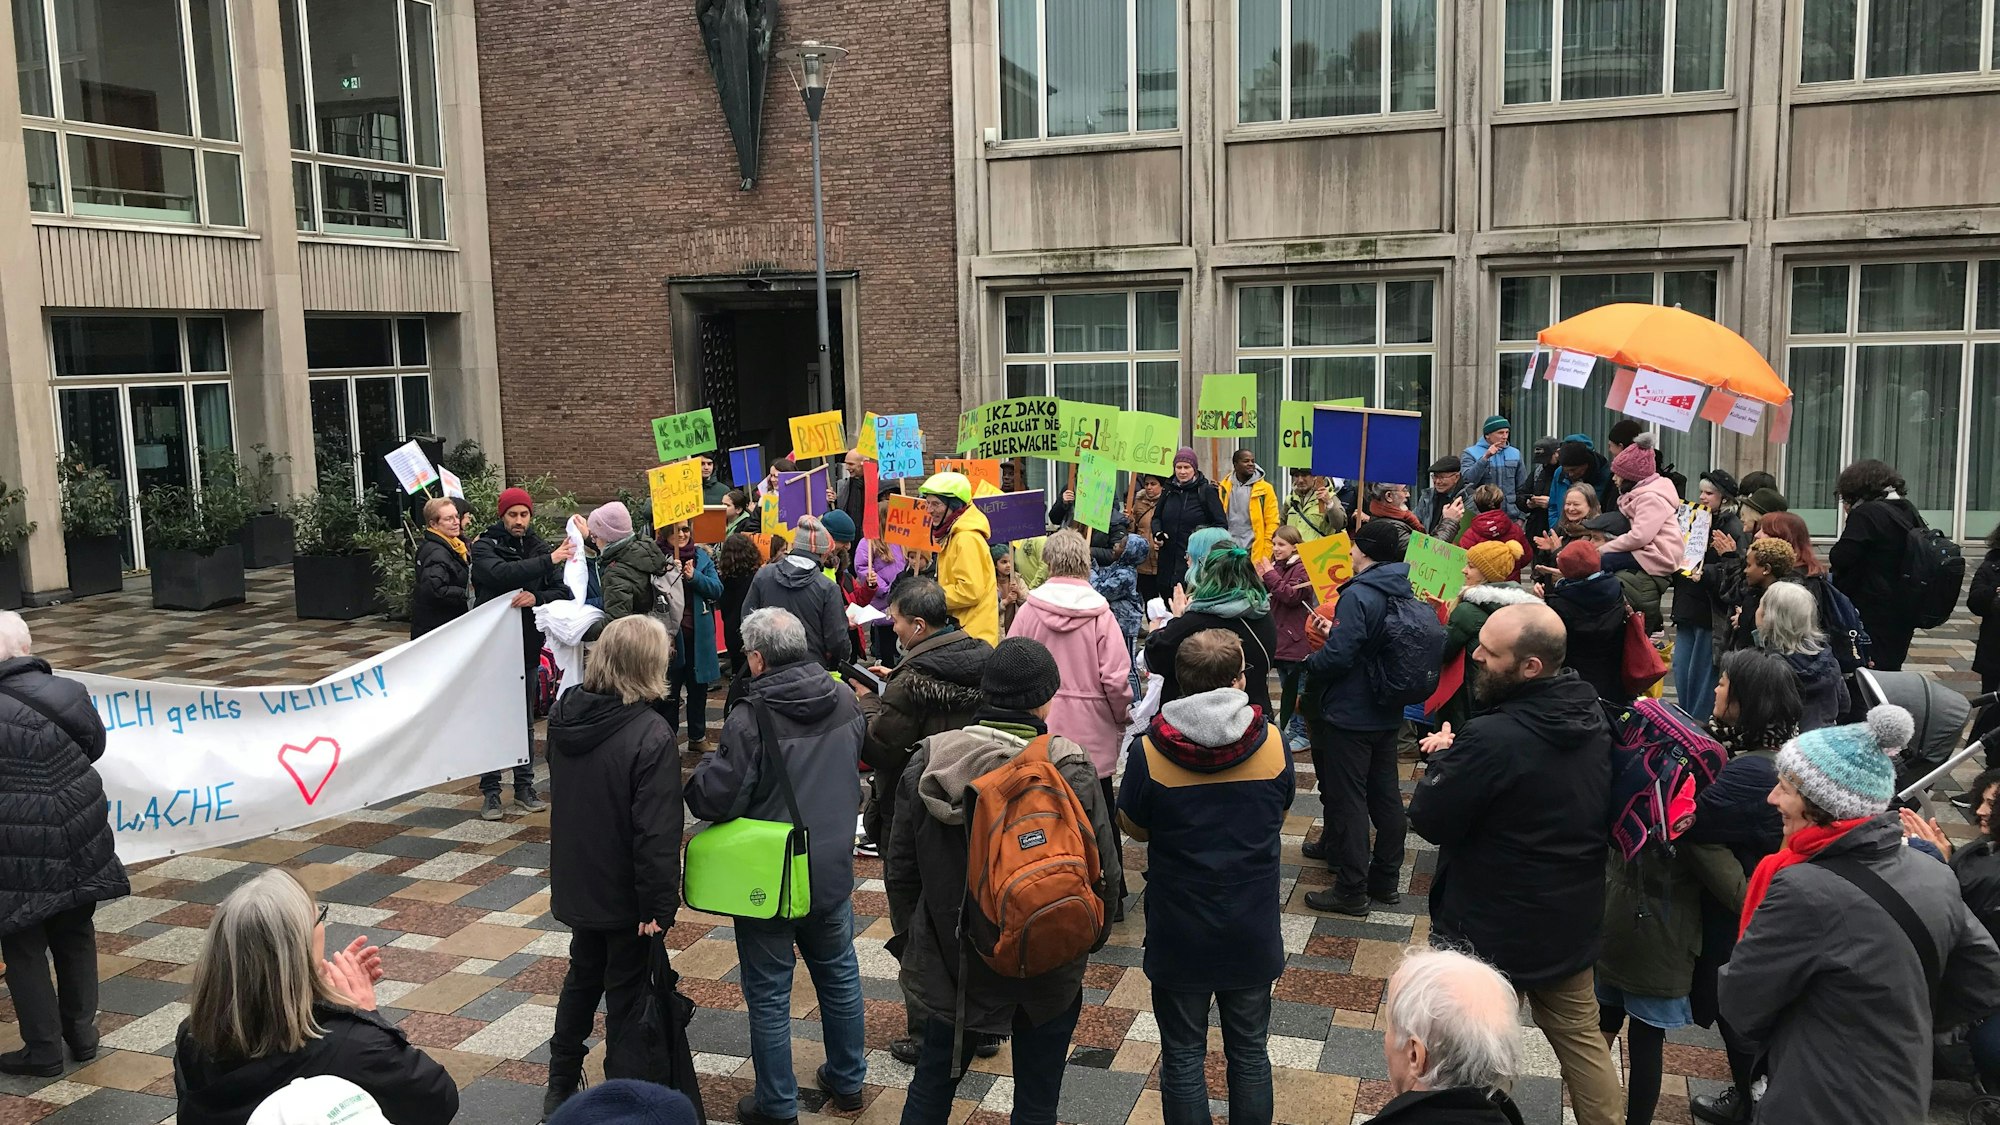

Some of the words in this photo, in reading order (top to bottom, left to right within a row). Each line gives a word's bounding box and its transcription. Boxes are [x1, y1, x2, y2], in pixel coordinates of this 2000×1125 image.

[984, 418, 1040, 439] BRAUCHT
[986, 404, 1012, 423] IKZ
[1015, 400, 1057, 418] DAKO
[978, 432, 1058, 460] FEUERWACHE
[1059, 416, 1113, 457] elfalt
[1132, 424, 1172, 466] der
[881, 458, 917, 473] SIND
[166, 690, 242, 734] gehts
[106, 781, 240, 832] WACHE
